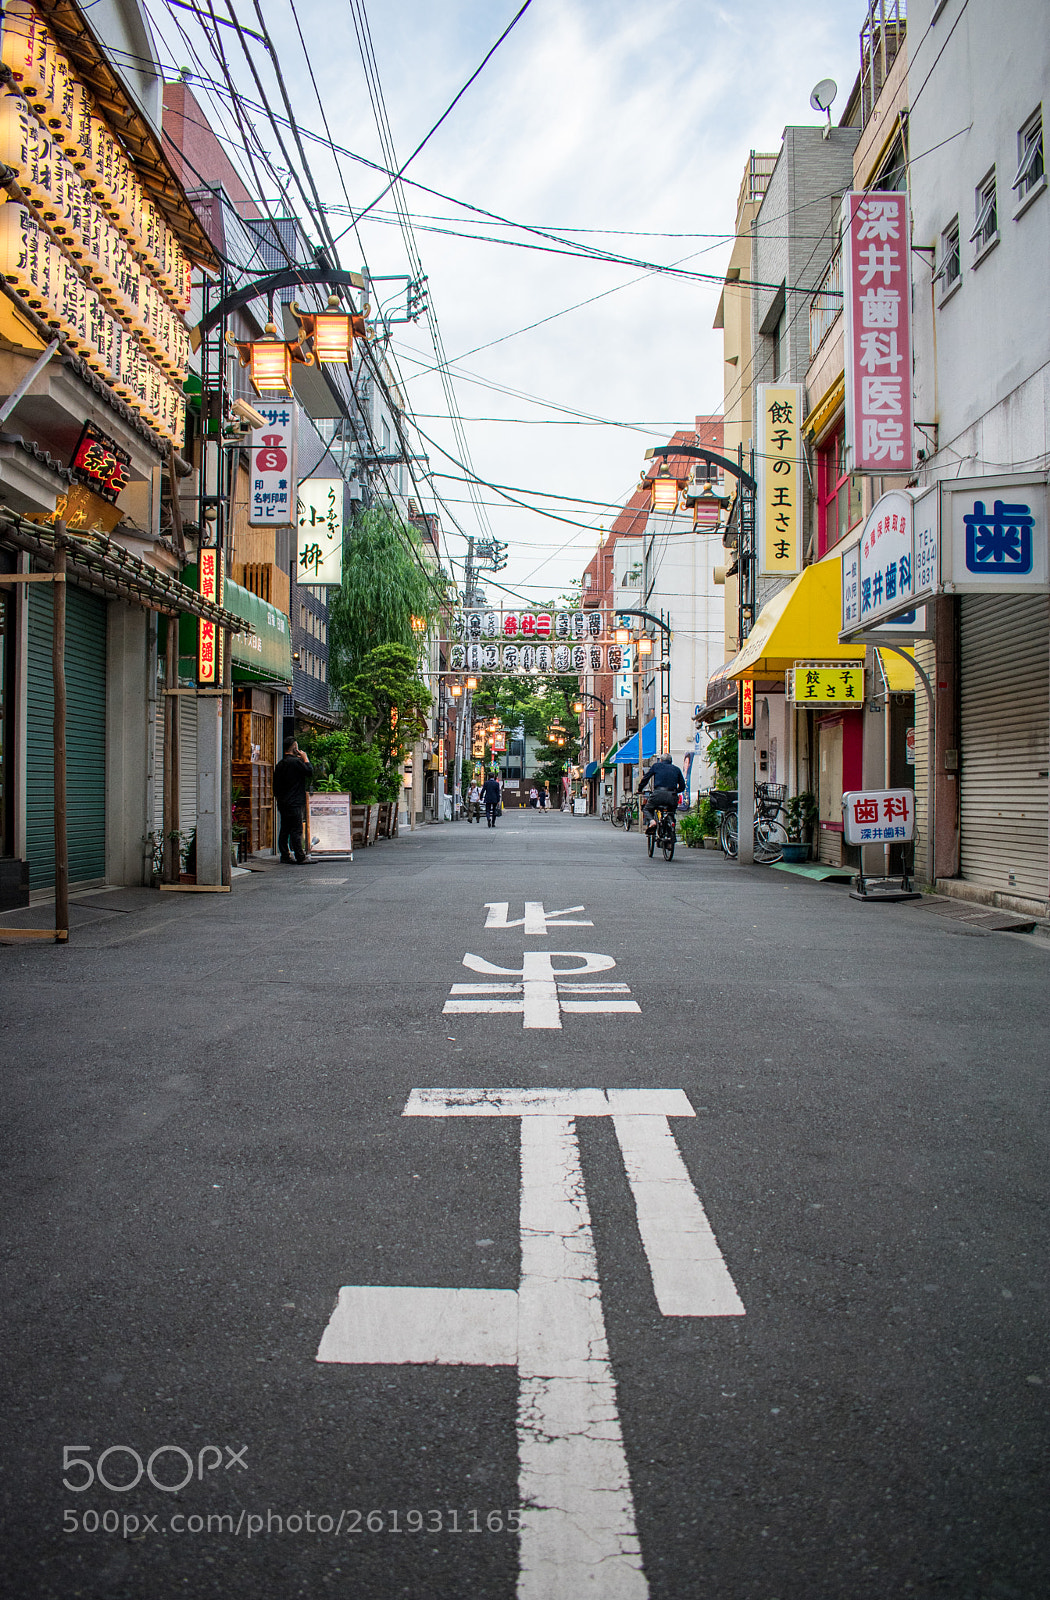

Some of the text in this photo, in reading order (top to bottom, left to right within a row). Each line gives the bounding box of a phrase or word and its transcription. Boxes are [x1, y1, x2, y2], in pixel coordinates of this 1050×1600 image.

[857, 201, 904, 461] 深井歯科医院
[254, 479, 288, 491] 印章
[768, 401, 794, 559] 餃子の王さま
[254, 492, 288, 504] 名刺印刷
[254, 506, 287, 517] コピー
[299, 505, 326, 577] 小柳
[919, 528, 934, 549] TEL
[963, 500, 1036, 575] 歯
[861, 552, 911, 614] 深井歯科
[917, 565, 935, 588] 1831
[202, 554, 215, 679] 浅草央通り
[805, 671, 854, 685] 餃子
[804, 685, 855, 699] 王さま
[853, 796, 909, 825] 歯科
[860, 826, 906, 839] 深井歯科
